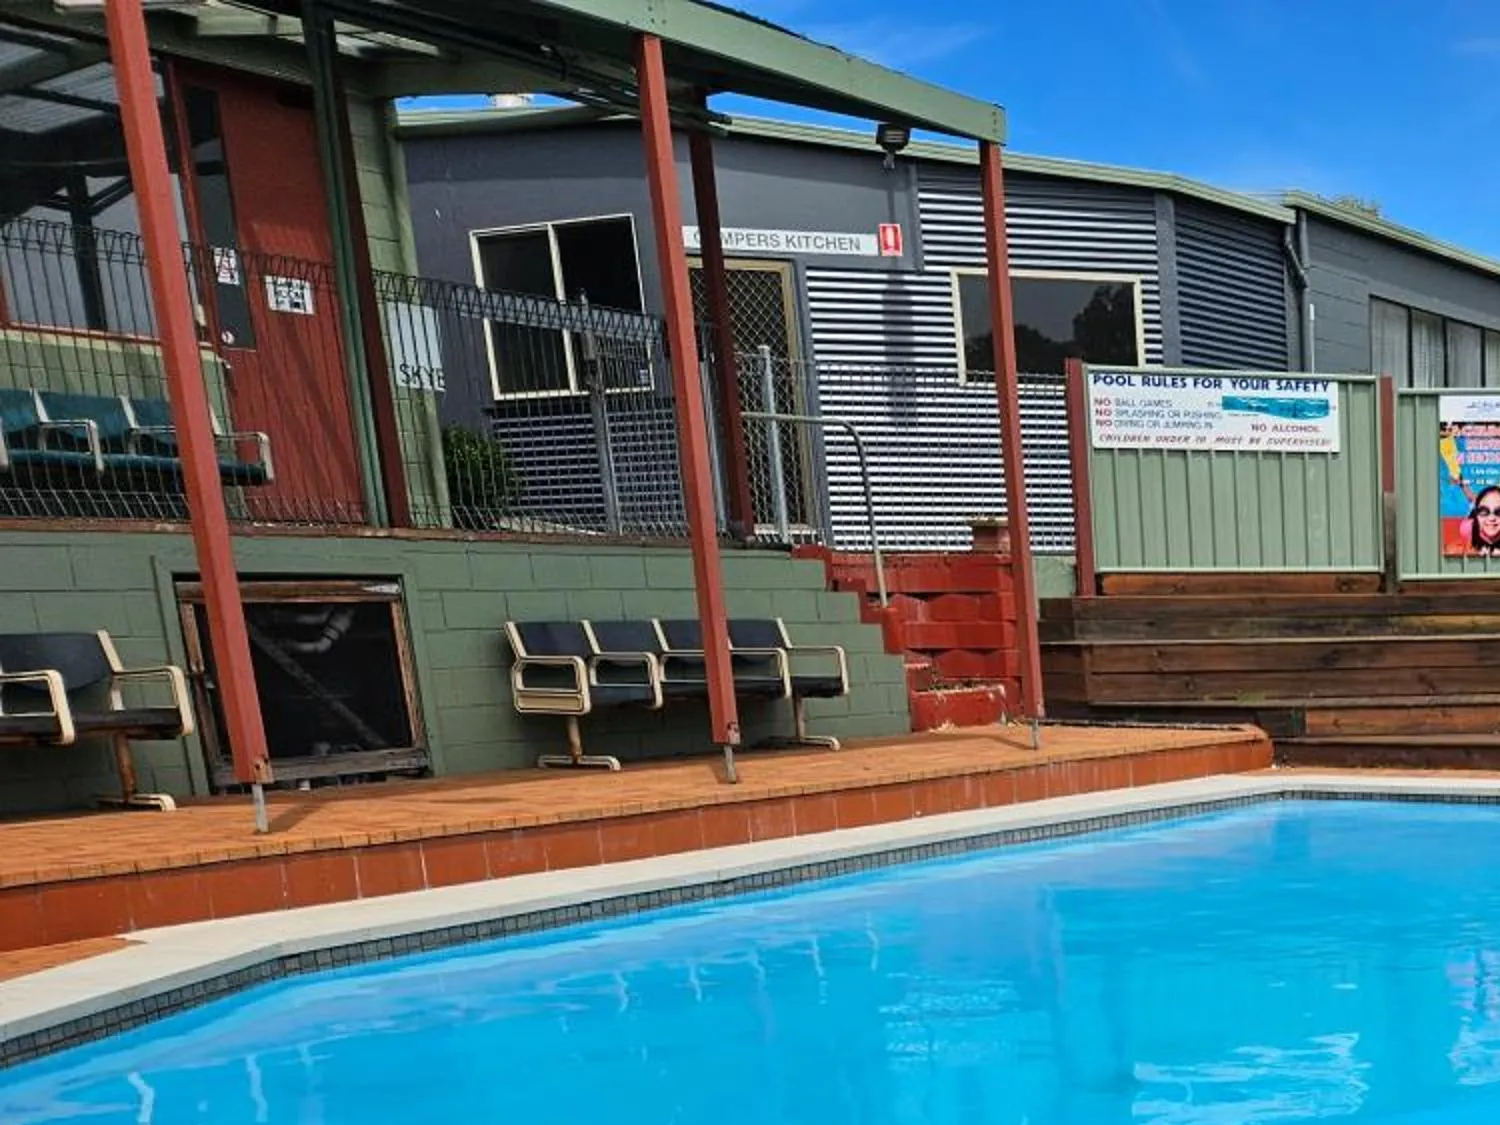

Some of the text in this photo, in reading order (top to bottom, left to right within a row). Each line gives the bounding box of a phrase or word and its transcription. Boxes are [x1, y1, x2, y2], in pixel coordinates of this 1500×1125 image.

[694, 232, 861, 251] CMPERS KITCHEN
[1093, 374, 1329, 392] POOL RULES FOR YOUR SAFETY
[1094, 397, 1112, 406] NO
[1095, 408, 1113, 417] NO
[1095, 419, 1113, 427] NO
[1251, 423, 1320, 433] NO ALCOHOL
